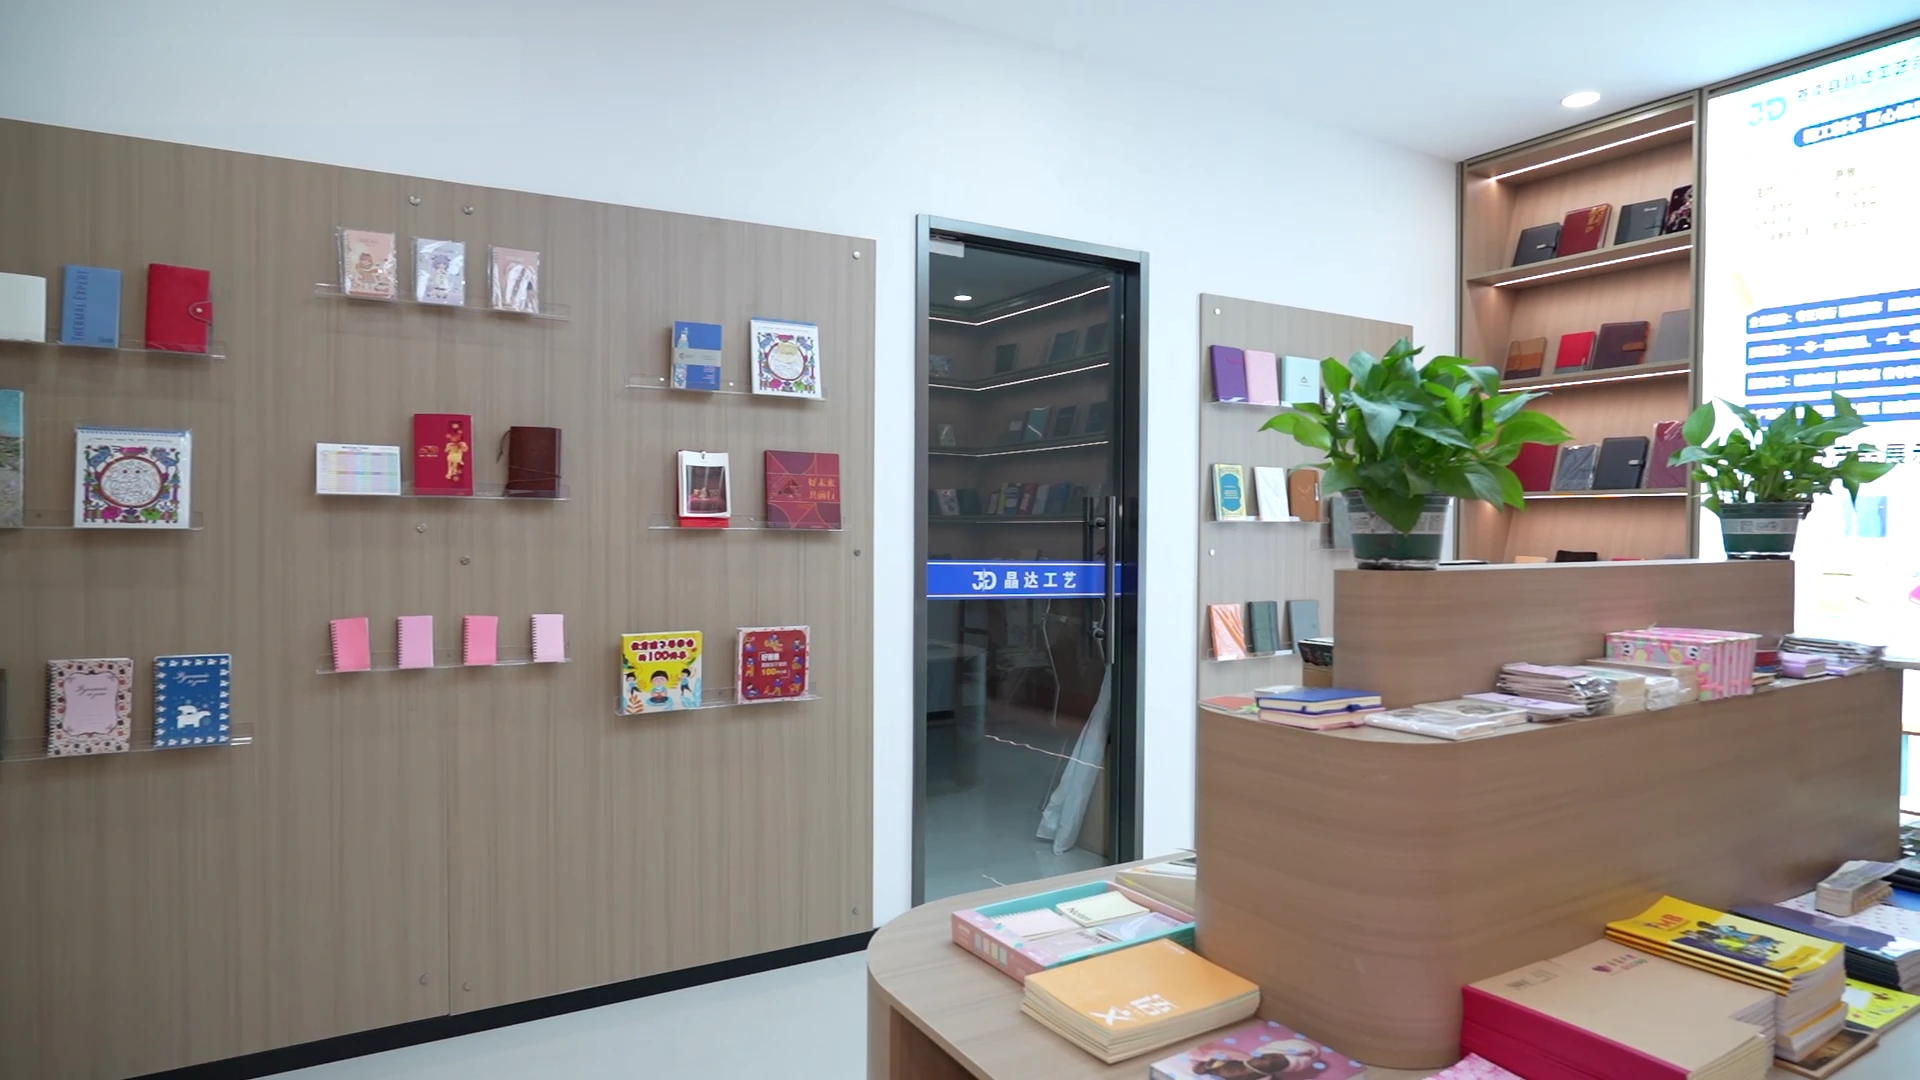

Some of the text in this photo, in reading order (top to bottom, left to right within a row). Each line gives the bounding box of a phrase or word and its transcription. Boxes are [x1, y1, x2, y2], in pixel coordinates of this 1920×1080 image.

[70, 269, 89, 341] THERMAL EXPERT
[1004, 571, 1077, 589] 晶达工艺
